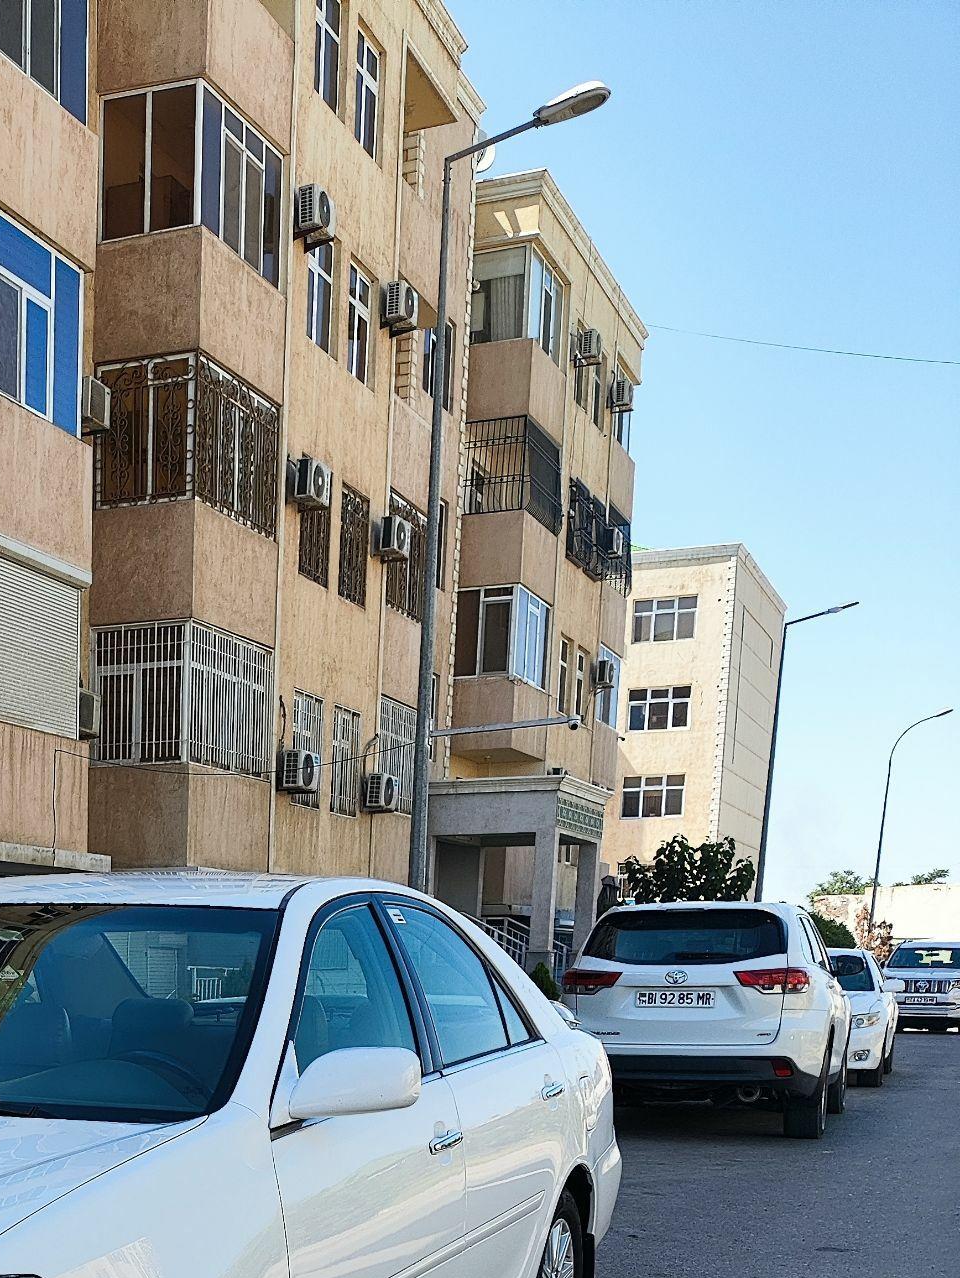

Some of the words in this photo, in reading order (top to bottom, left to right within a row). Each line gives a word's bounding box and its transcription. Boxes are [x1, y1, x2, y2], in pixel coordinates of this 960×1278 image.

[647, 992, 657, 1005] BI
[659, 992, 676, 1005] 92
[677, 992, 694, 1005] 85
[696, 992, 712, 1006] MR
